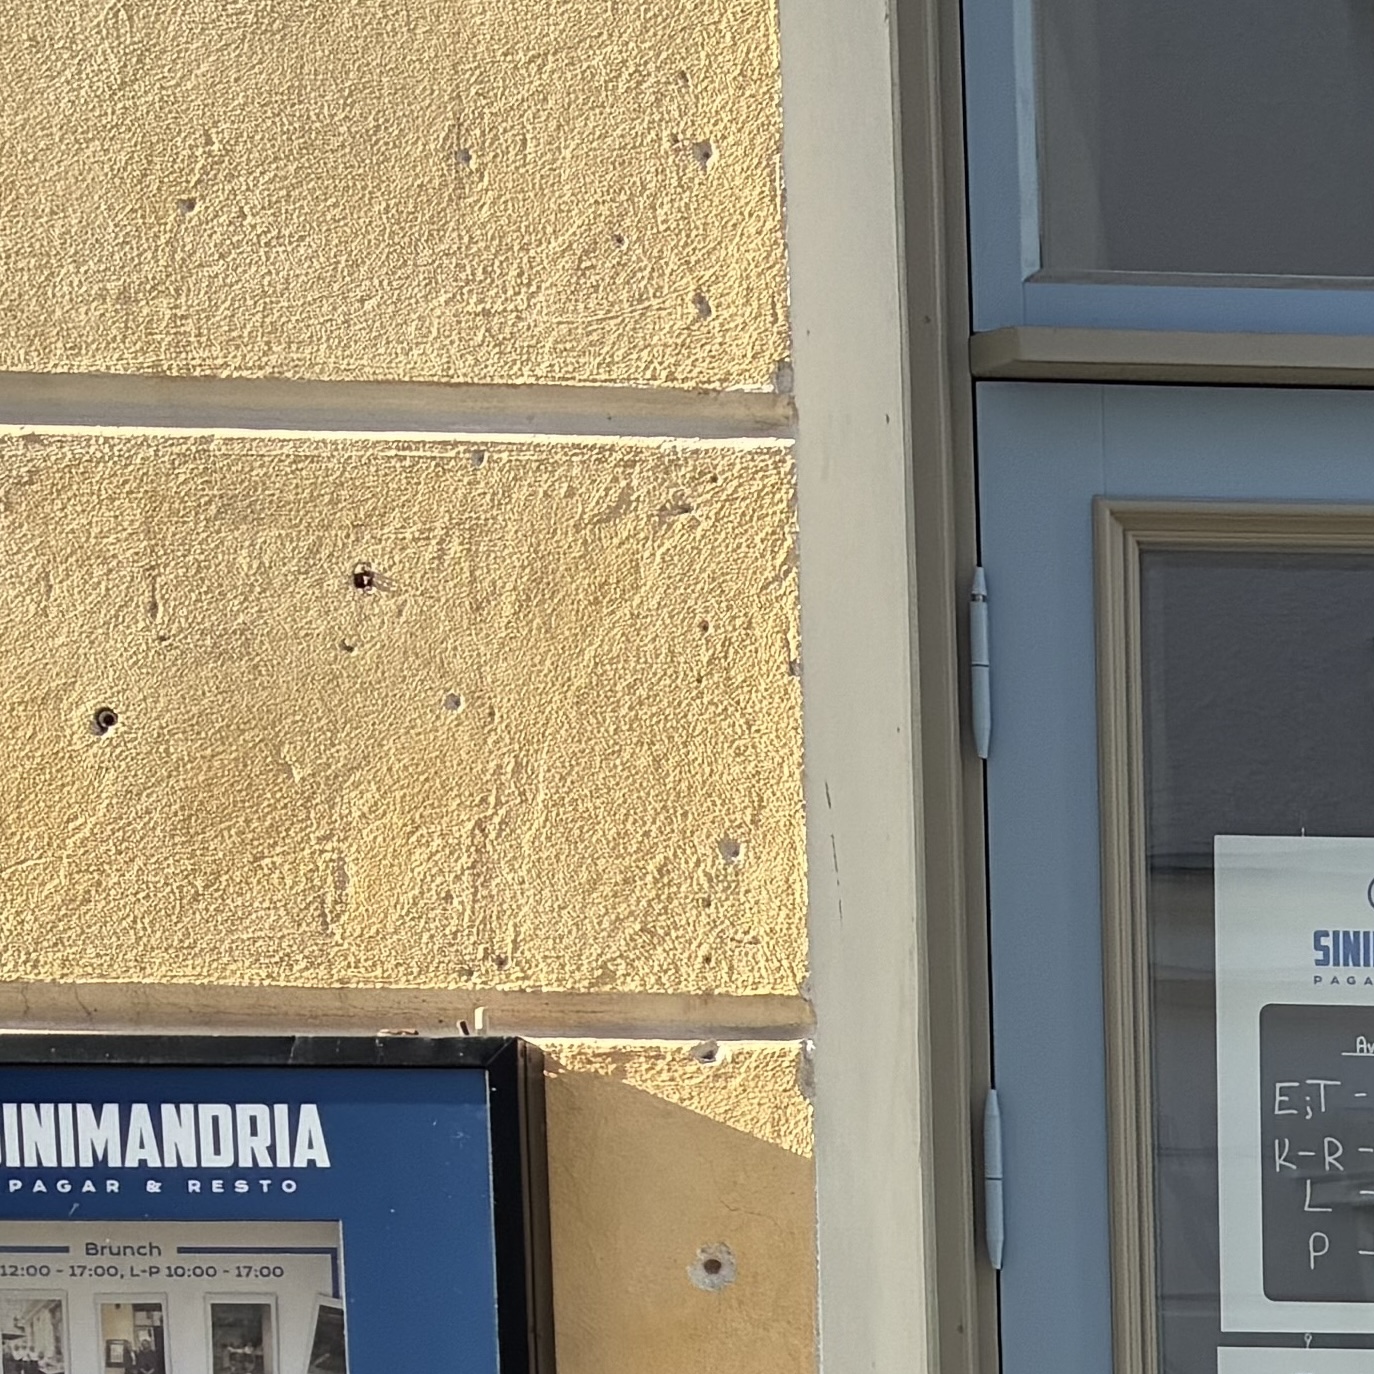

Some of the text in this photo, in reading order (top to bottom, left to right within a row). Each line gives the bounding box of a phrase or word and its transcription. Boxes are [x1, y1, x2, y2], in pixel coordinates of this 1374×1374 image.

[1274, 1079, 1341, 1119] E;T
[0, 1103, 331, 1168] INIMANDRIA
[8, 1180, 297, 1193] PAGAR & RESTO
[1304, 1179, 1332, 1211] L
[84, 1242, 162, 1257] Brunch
[1308, 1232, 1329, 1270] P
[0, 1265, 51, 1278] 12:00
[69, 1265, 125, 1280] 17:00,
[129, 1266, 160, 1278] L-P
[165, 1266, 217, 1278] 10:00
[235, 1266, 284, 1278] 17:00
